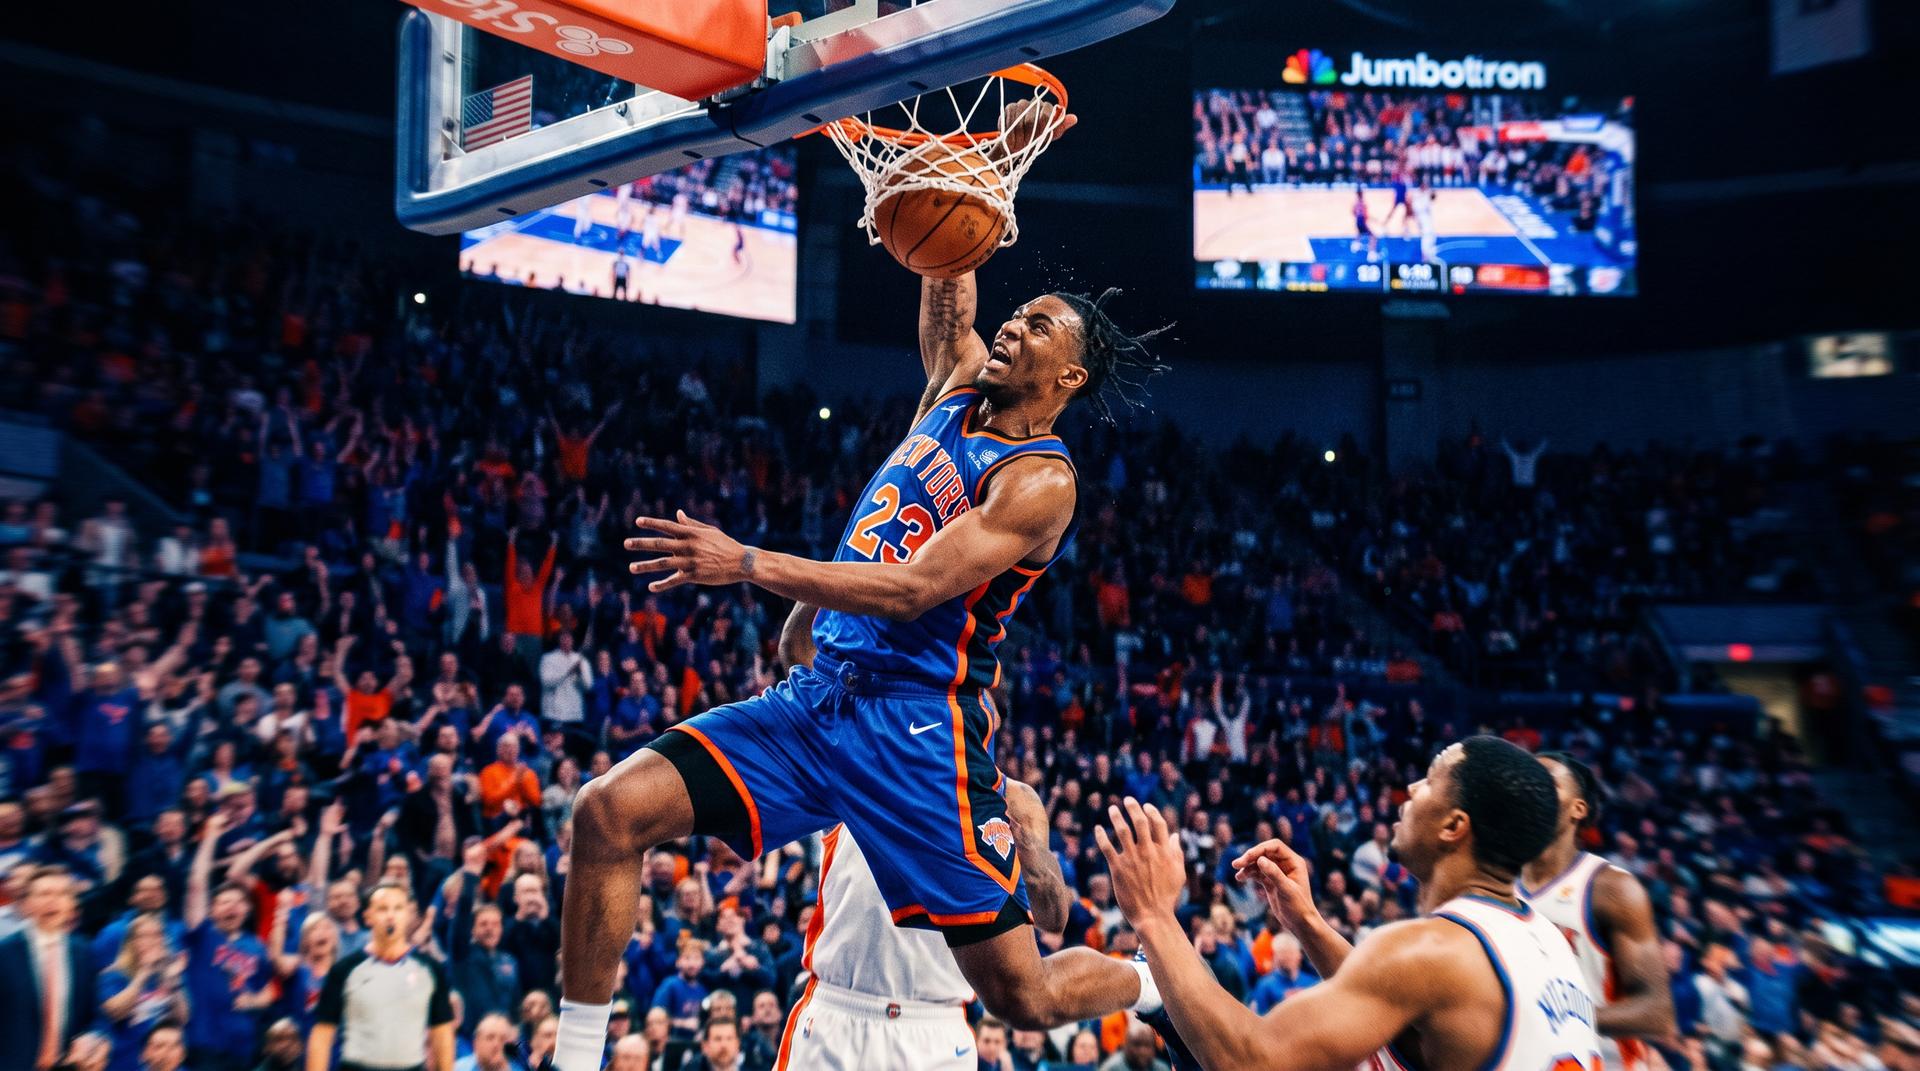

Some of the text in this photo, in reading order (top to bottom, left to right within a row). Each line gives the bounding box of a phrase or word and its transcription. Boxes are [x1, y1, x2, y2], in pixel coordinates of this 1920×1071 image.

[440, 0, 560, 34] St
[884, 434, 940, 470] EW
[846, 482, 936, 565] 23
